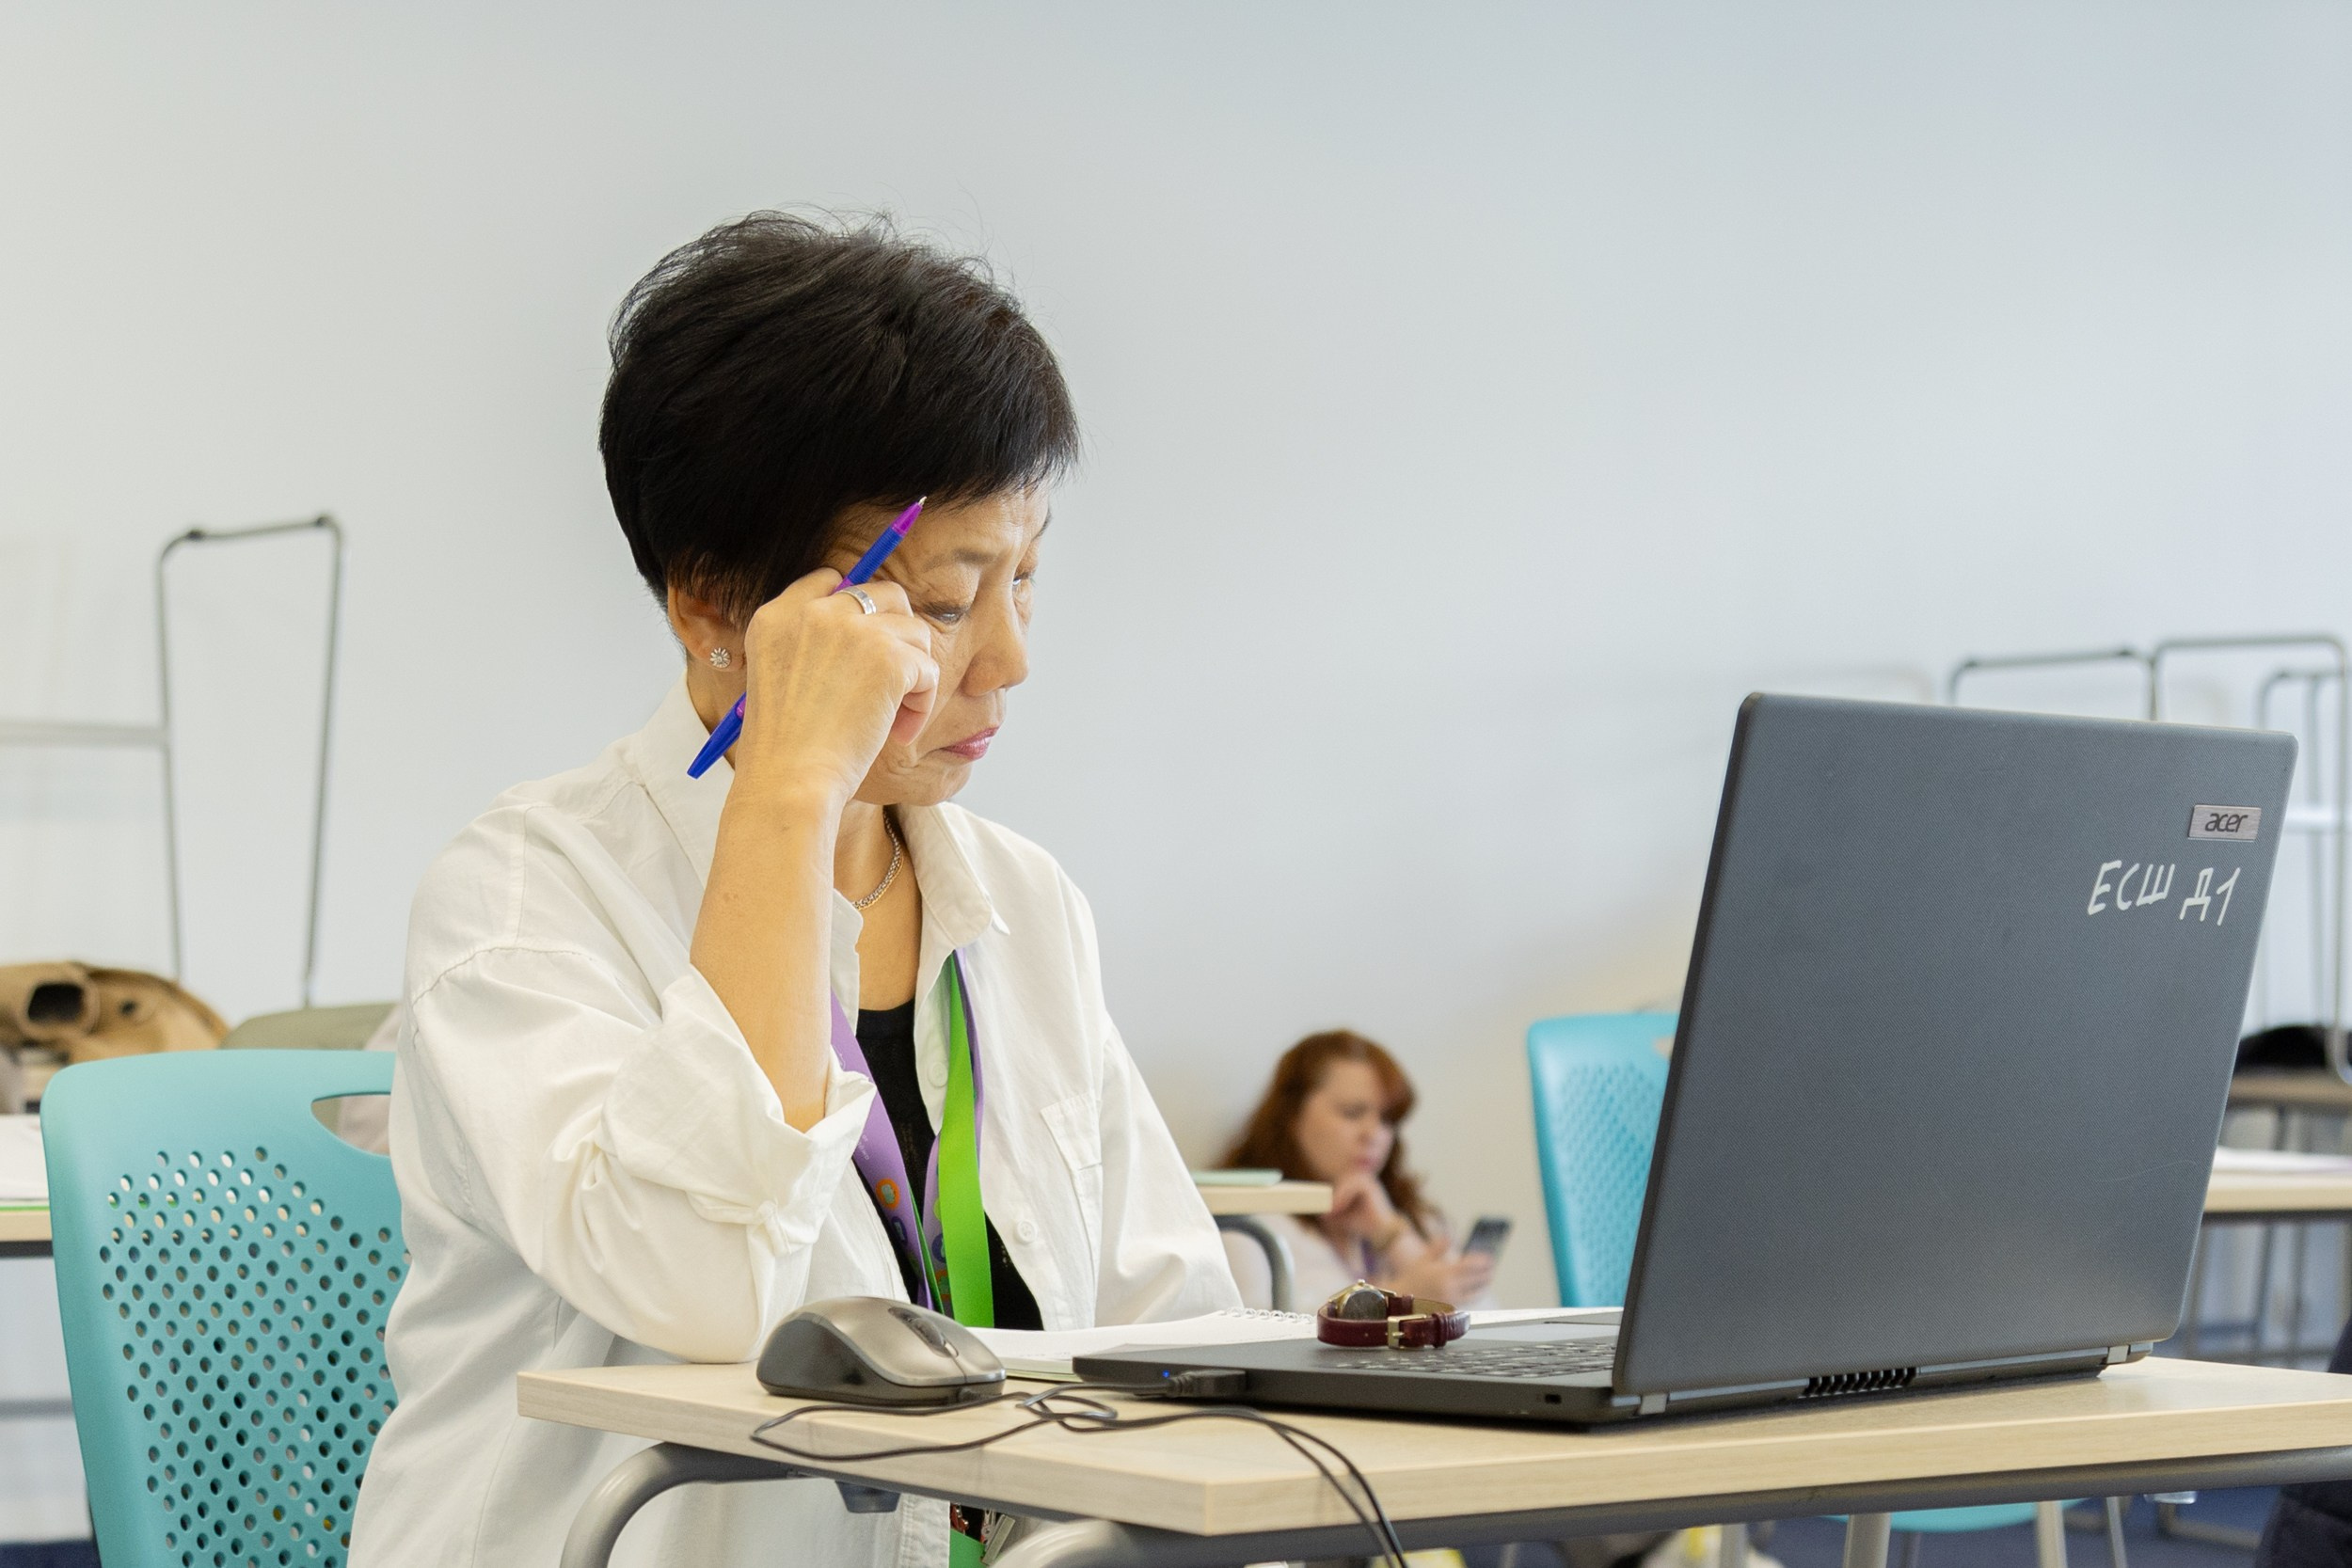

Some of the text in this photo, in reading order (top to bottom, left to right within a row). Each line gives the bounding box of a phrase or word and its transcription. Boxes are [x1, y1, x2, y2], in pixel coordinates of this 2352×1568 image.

[2204, 812, 2249, 832] acer
[2087, 860, 2241, 927] ЕСШ Д1
